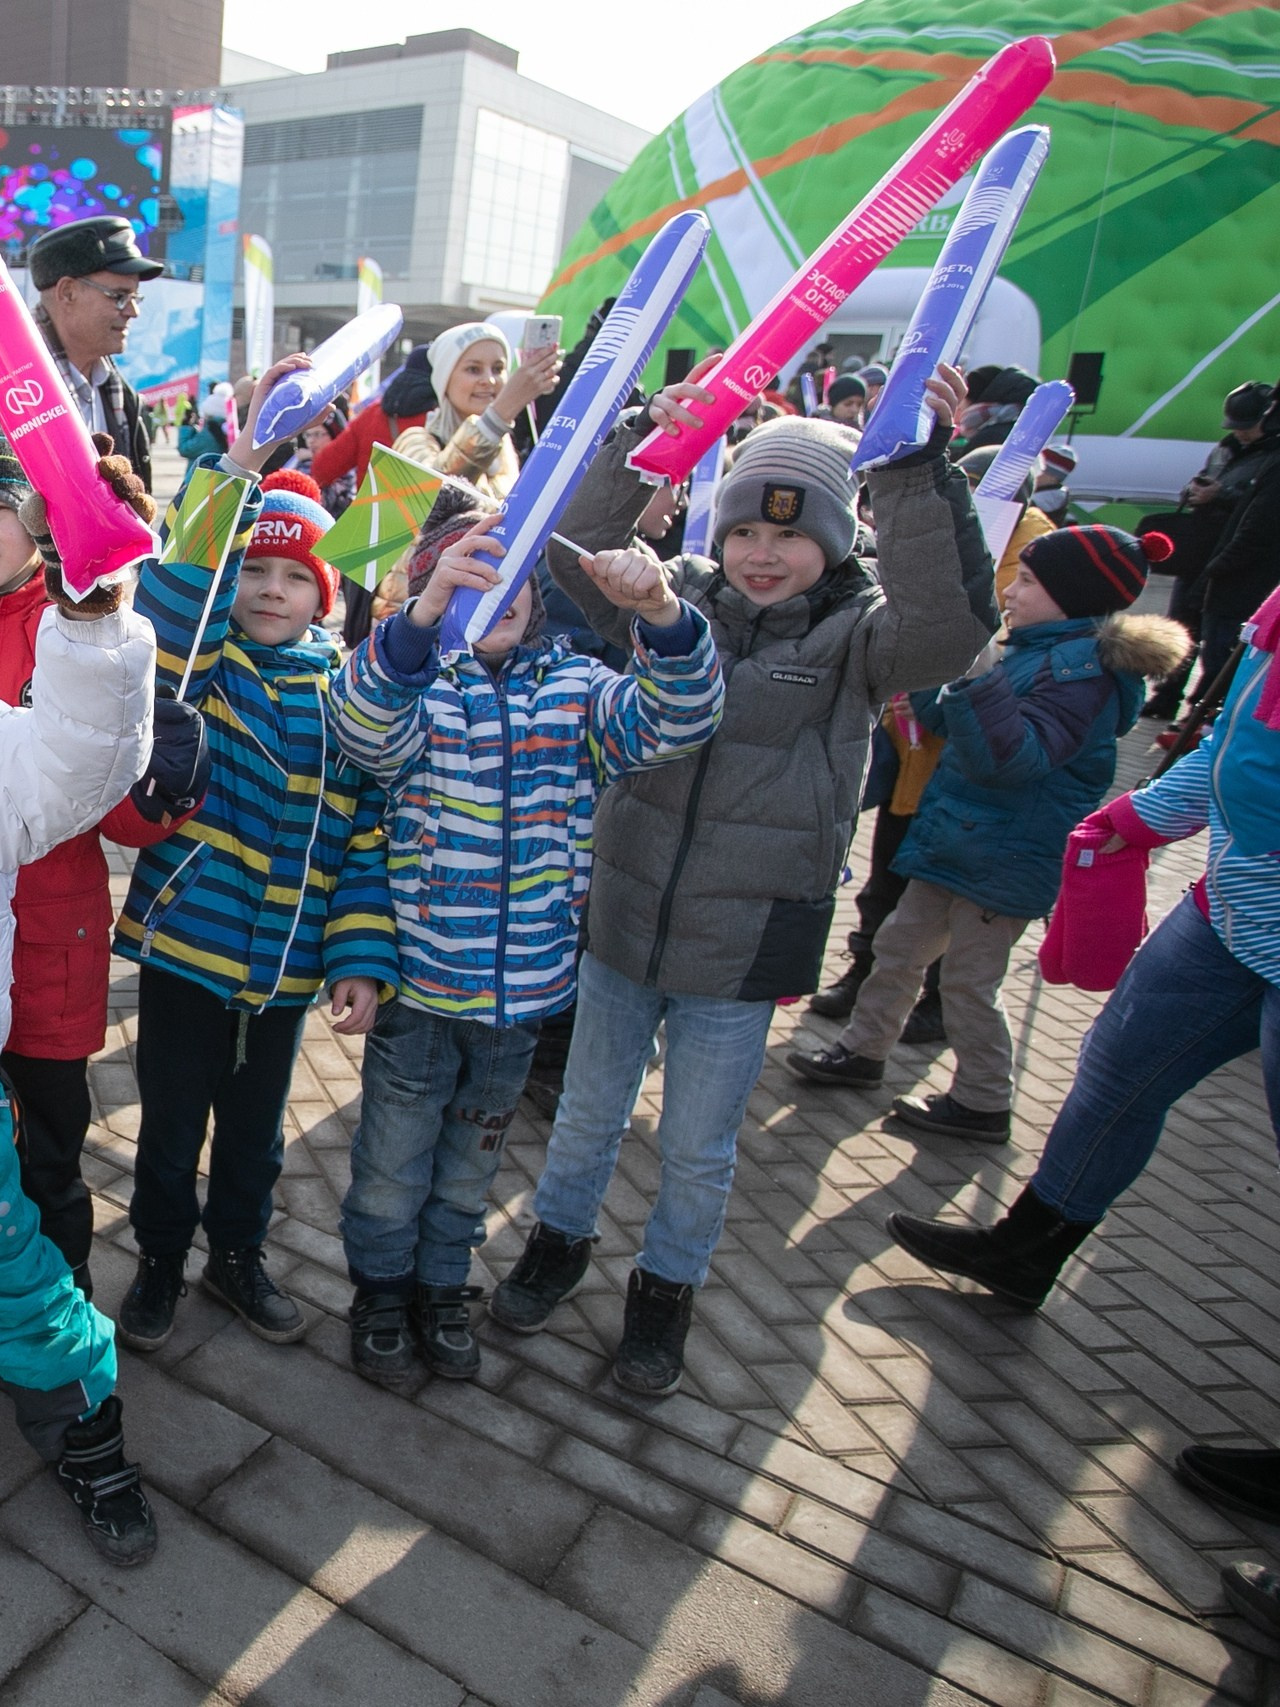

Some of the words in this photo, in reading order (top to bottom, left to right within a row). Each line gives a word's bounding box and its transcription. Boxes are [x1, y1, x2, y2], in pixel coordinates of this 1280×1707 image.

[805, 288, 837, 315] ОГНЯ
[10, 404, 69, 442] NORNICKEL
[545, 442, 563, 451] 2019
